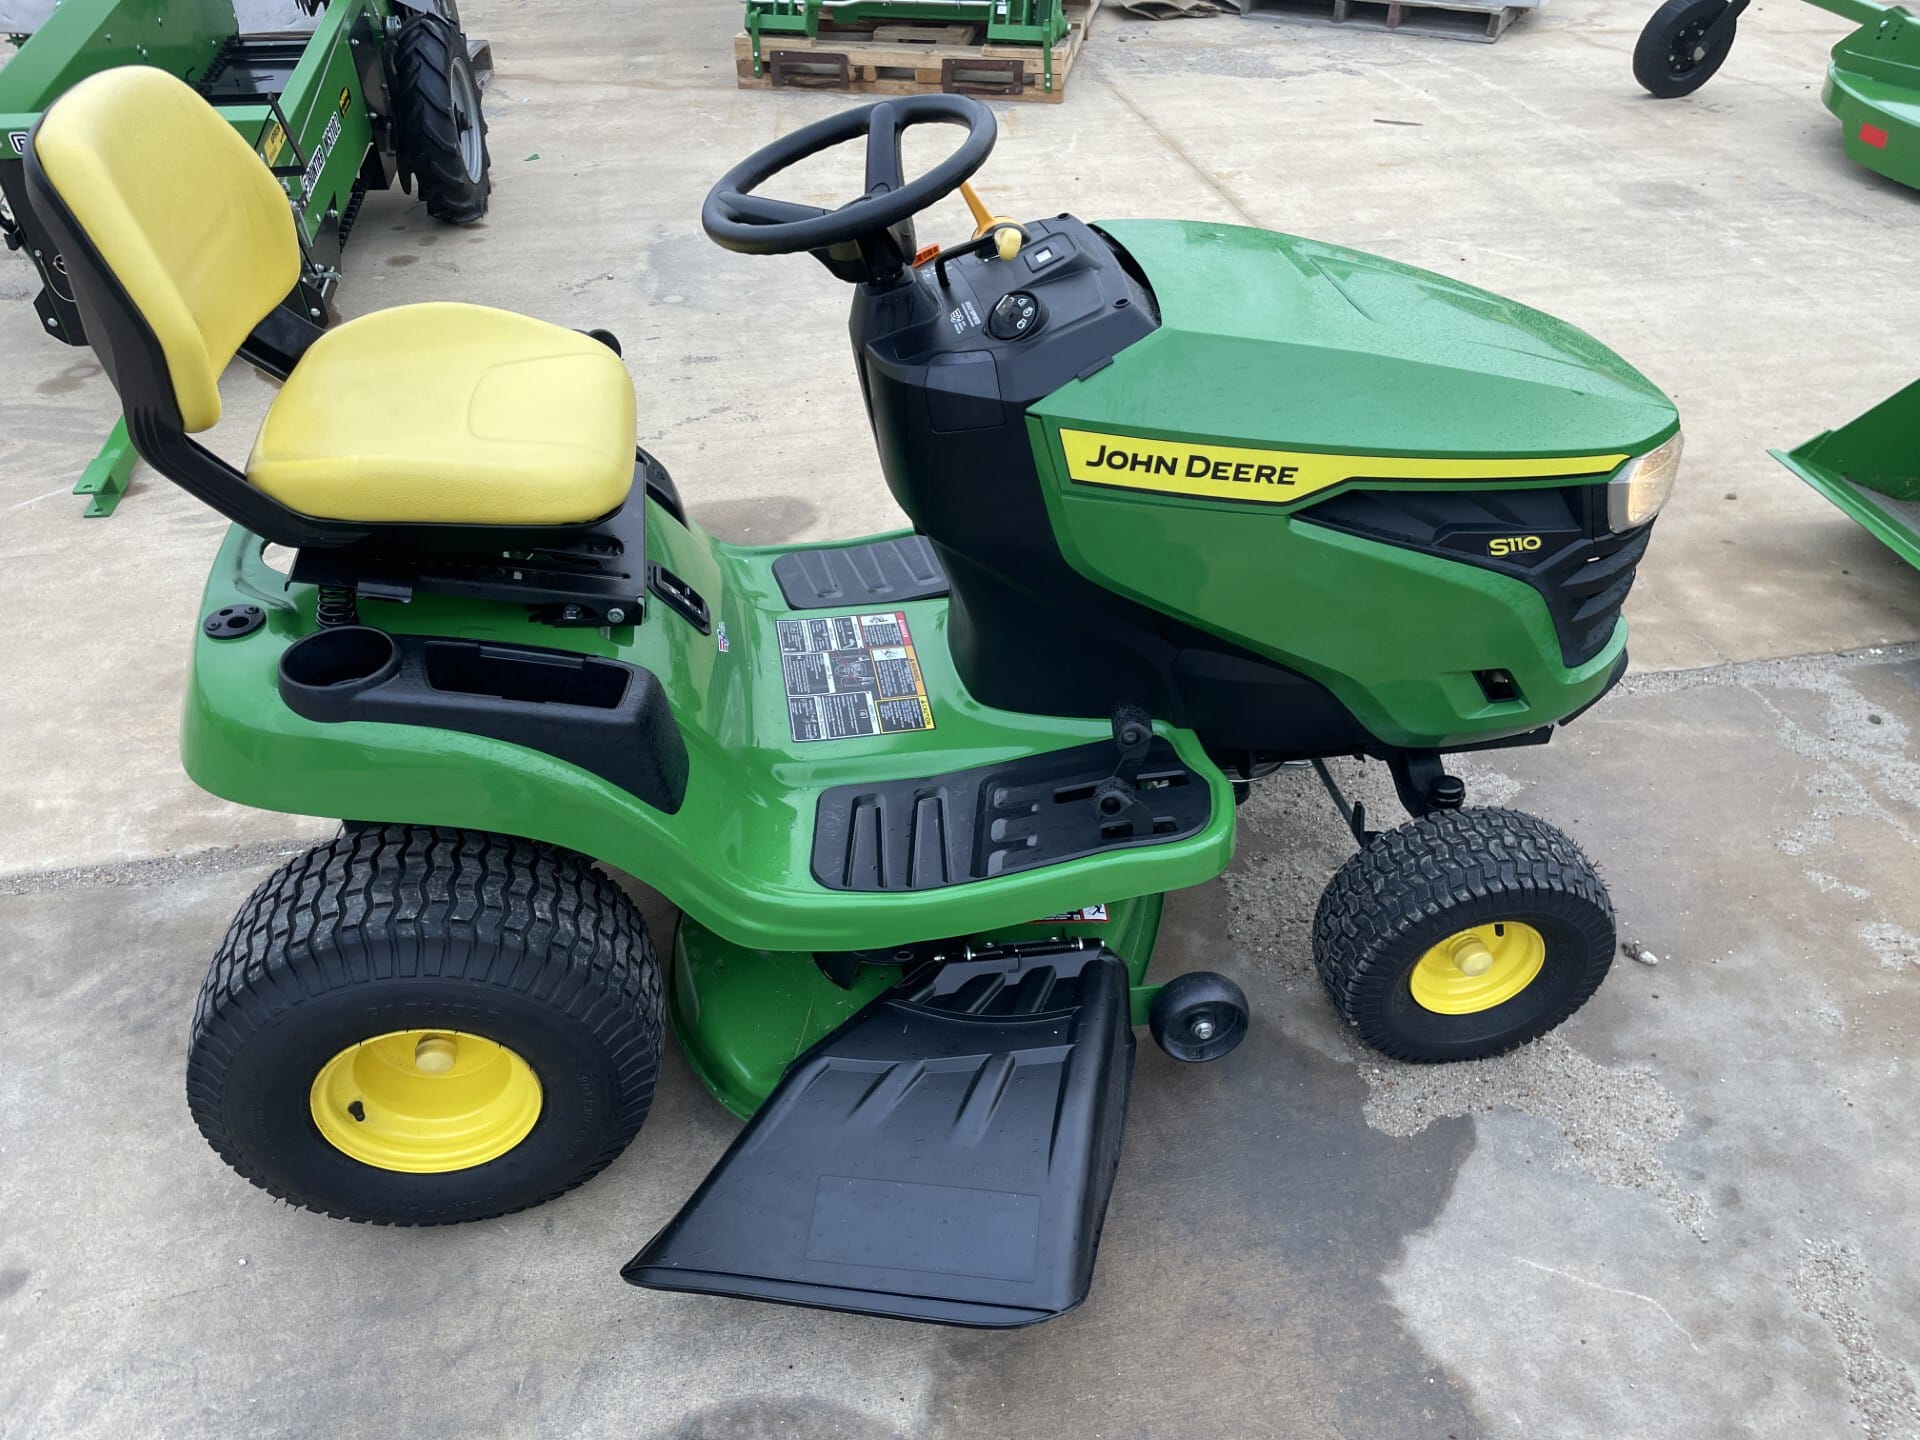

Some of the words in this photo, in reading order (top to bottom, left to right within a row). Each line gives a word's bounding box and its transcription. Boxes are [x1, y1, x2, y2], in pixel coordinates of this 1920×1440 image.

[1085, 445, 1178, 476] JOHN
[1185, 455, 1299, 485] DEERE
[1488, 535, 1542, 556] S110
[922, 704, 932, 726] CAUTION
